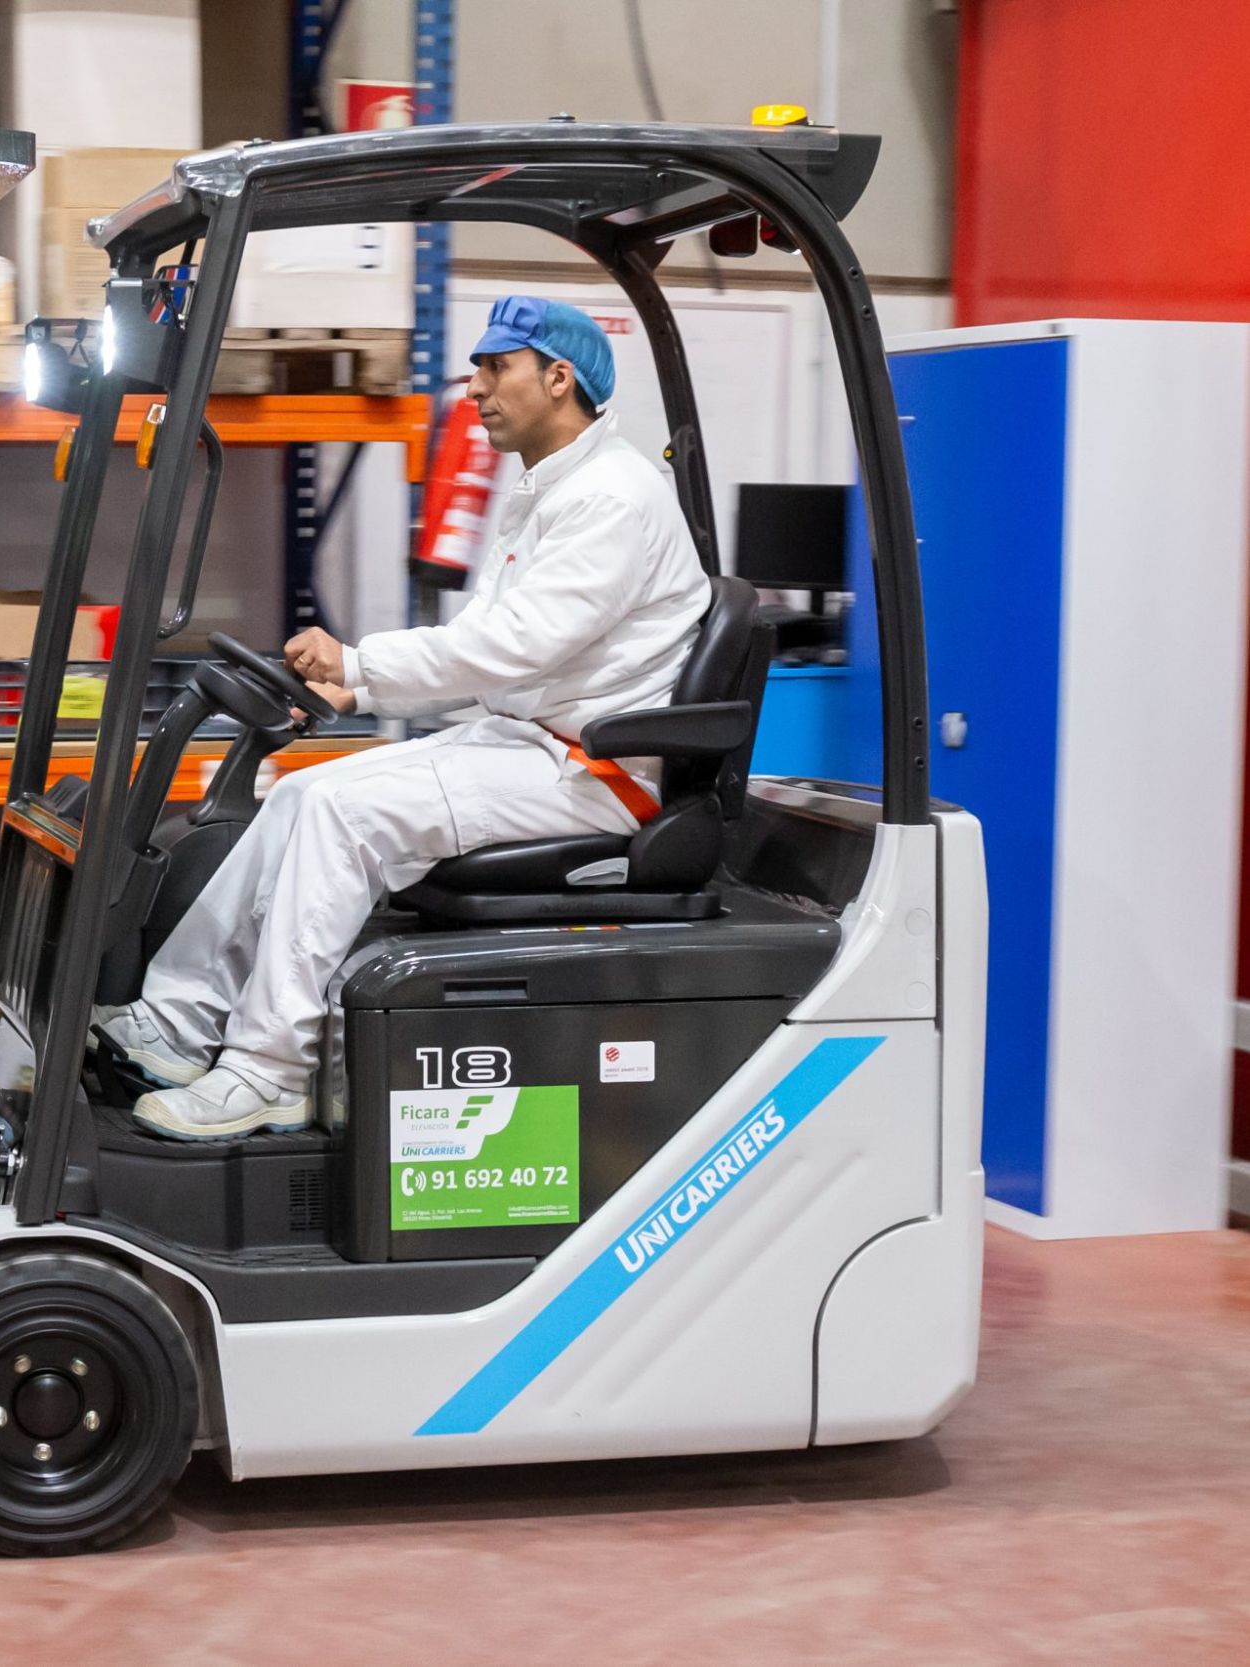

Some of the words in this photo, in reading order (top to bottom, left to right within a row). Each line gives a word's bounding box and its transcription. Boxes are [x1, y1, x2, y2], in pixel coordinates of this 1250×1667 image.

[416, 1046, 512, 1089] 18
[401, 1105, 449, 1120] Ficara
[431, 1170, 458, 1190] 91
[464, 1168, 503, 1188] 692
[509, 1167, 537, 1187] 40
[542, 1165, 568, 1185] 72
